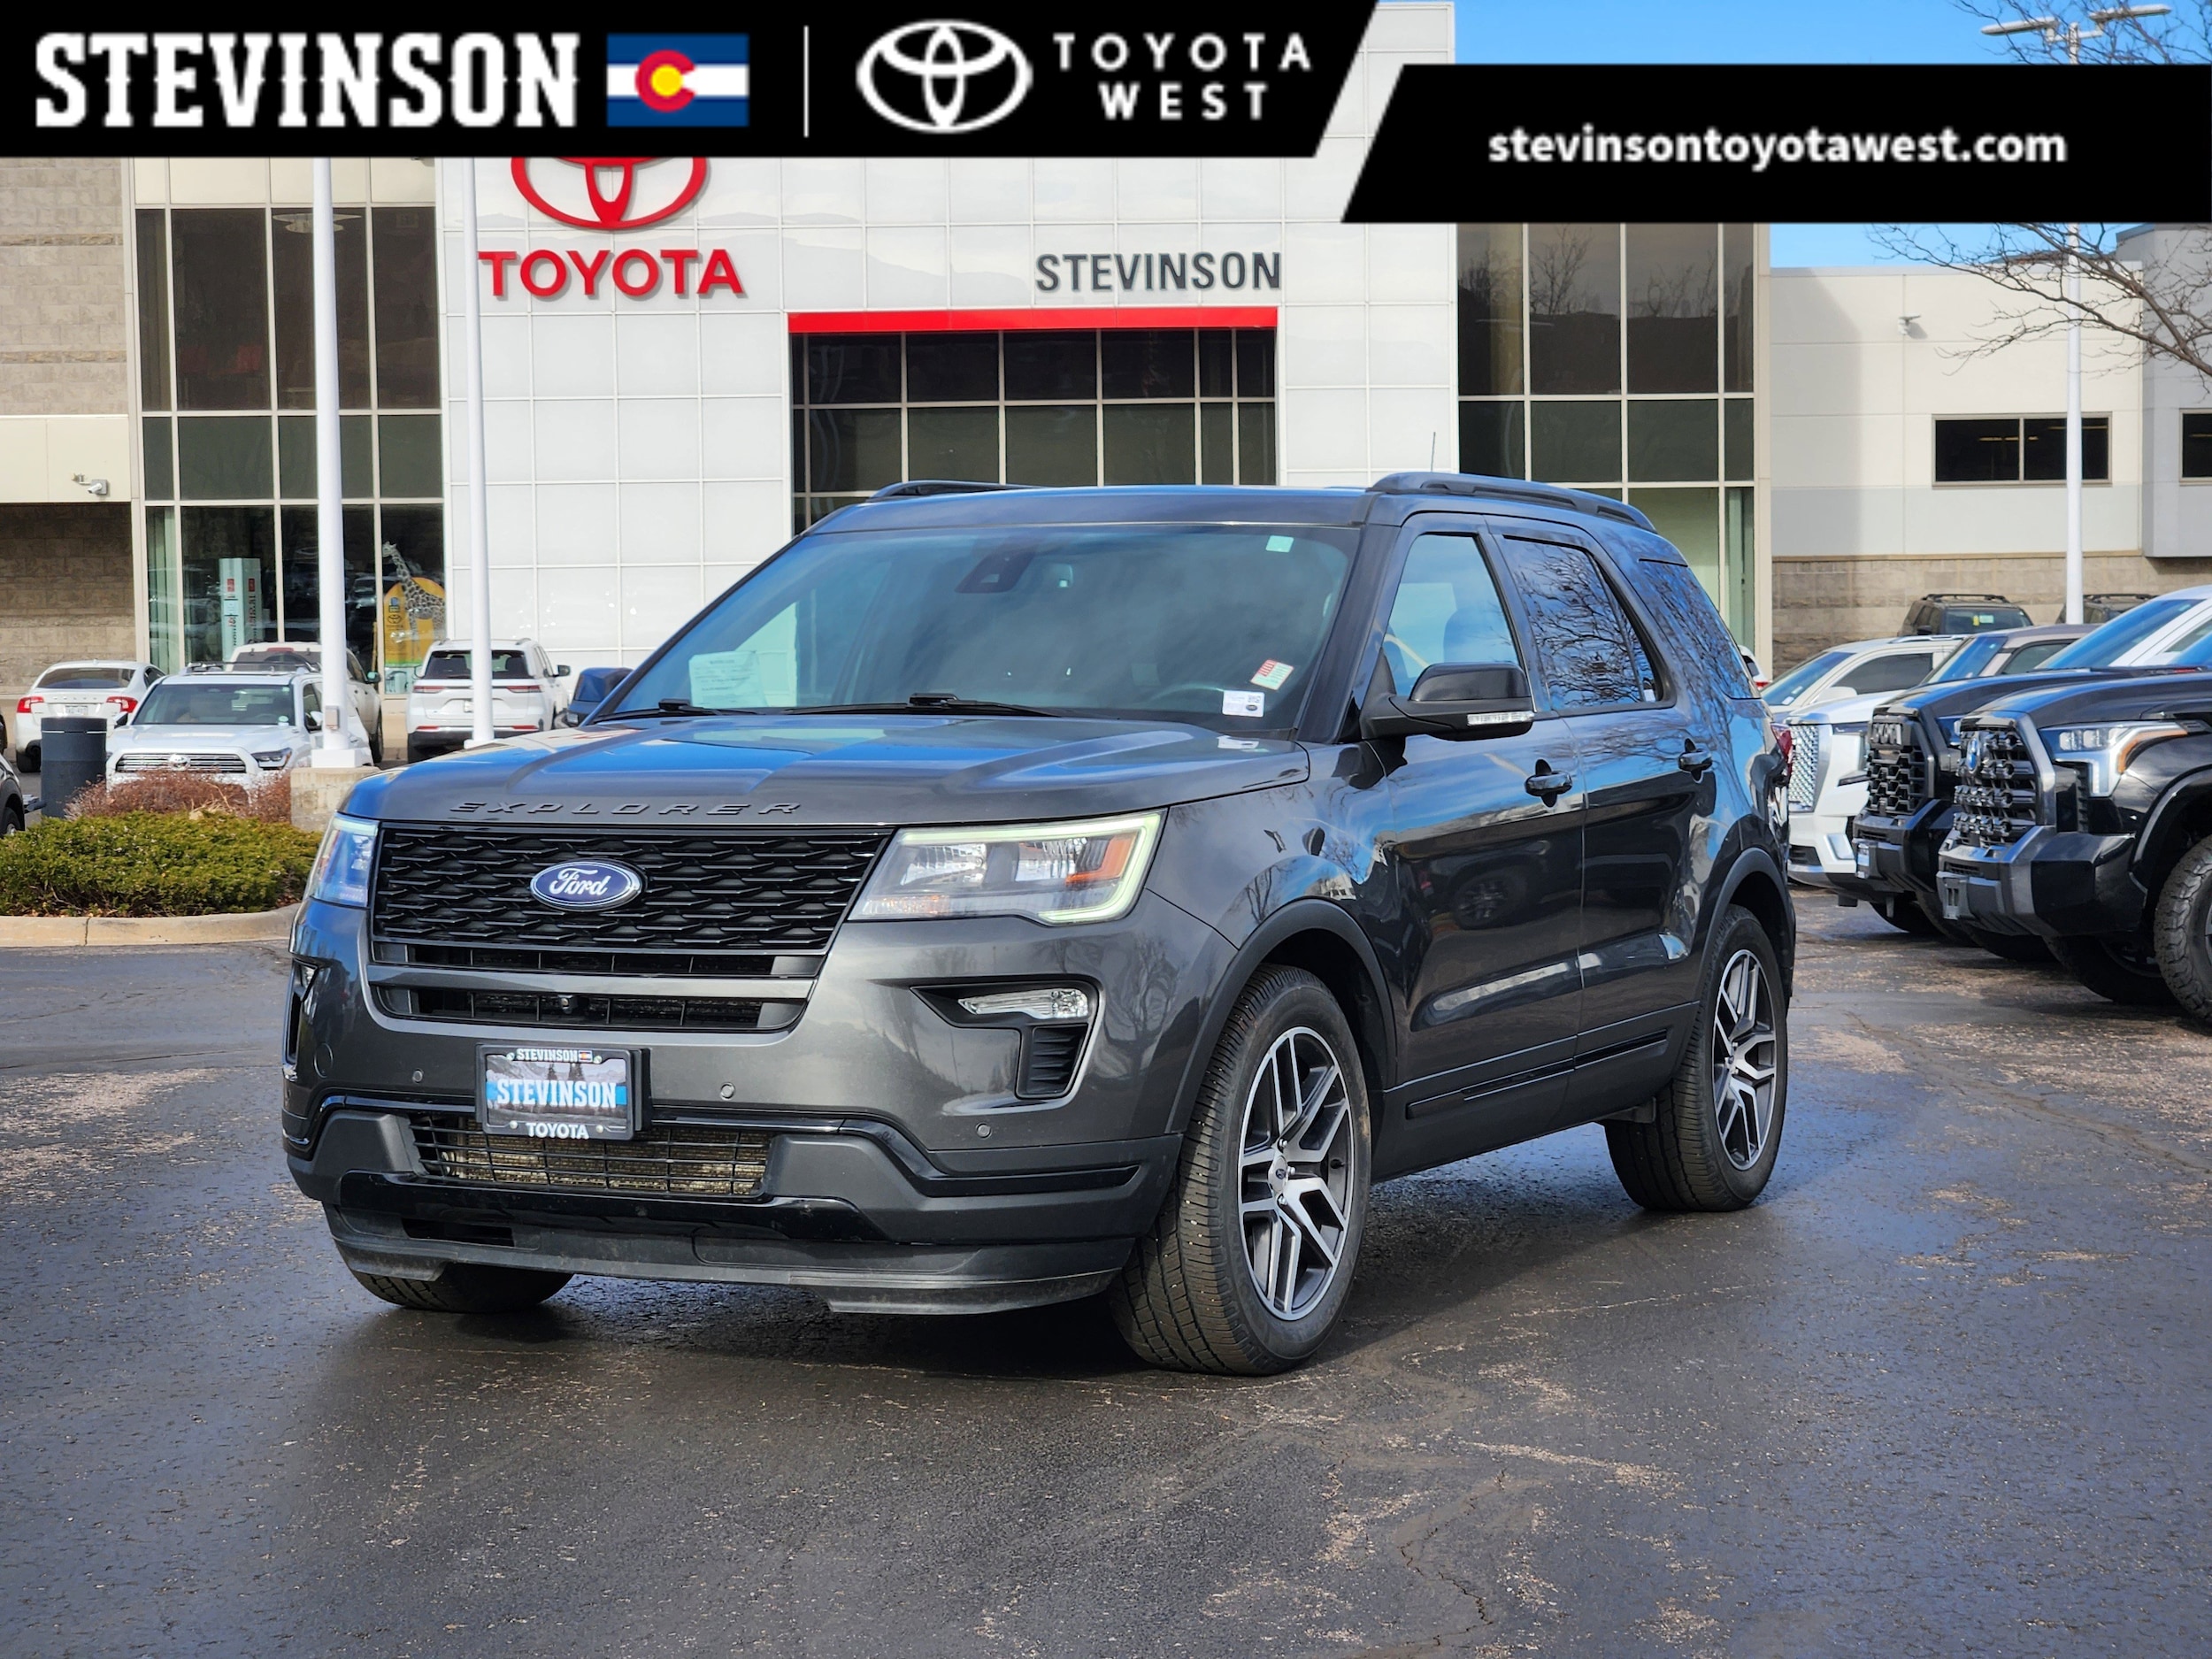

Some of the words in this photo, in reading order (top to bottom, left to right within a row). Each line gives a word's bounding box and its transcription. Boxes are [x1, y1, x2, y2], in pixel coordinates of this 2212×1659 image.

[478, 249, 744, 297] TOYOTA
[1036, 252, 1281, 292] STEVINSON
[449, 802, 800, 816] EXPLORER
[549, 867, 612, 896] Ford
[516, 1048, 578, 1063] STEVINSON
[496, 1079, 617, 1108] STEVINSON
[525, 1121, 590, 1140] TOYOTA
